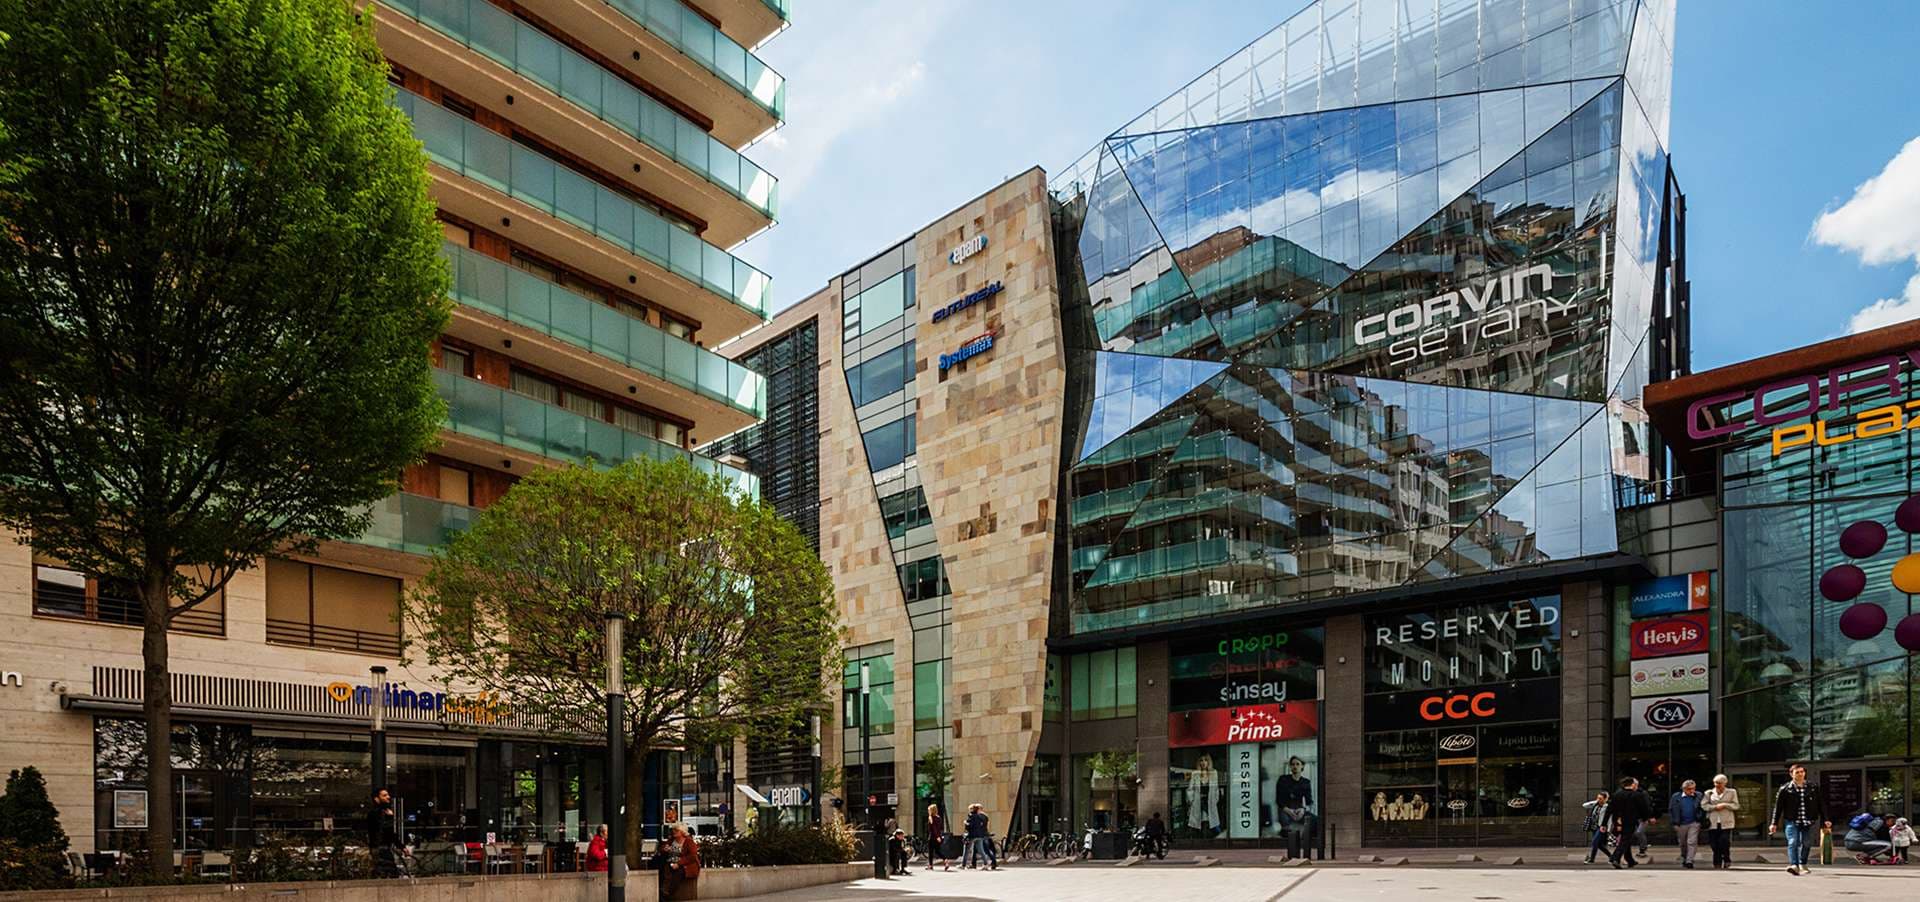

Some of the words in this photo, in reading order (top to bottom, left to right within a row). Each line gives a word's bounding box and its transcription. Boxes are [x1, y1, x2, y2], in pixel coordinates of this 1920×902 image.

[953, 235, 982, 264] epam
[932, 281, 1005, 323] FUTUREAL
[939, 335, 993, 370] Systemax
[1633, 591, 1685, 602] ALEXANDRA
[1376, 606, 1558, 645] RESERVED
[1643, 627, 1697, 645] Hervis
[1218, 632, 1288, 656] CROPP
[1391, 648, 1541, 685] MOHITO
[1220, 681, 1286, 701] sinsay
[1420, 692, 1496, 721] CCC
[1653, 706, 1686, 722] C&A
[771, 787, 801, 807] epam
[1240, 751, 1251, 828] RESERVED
